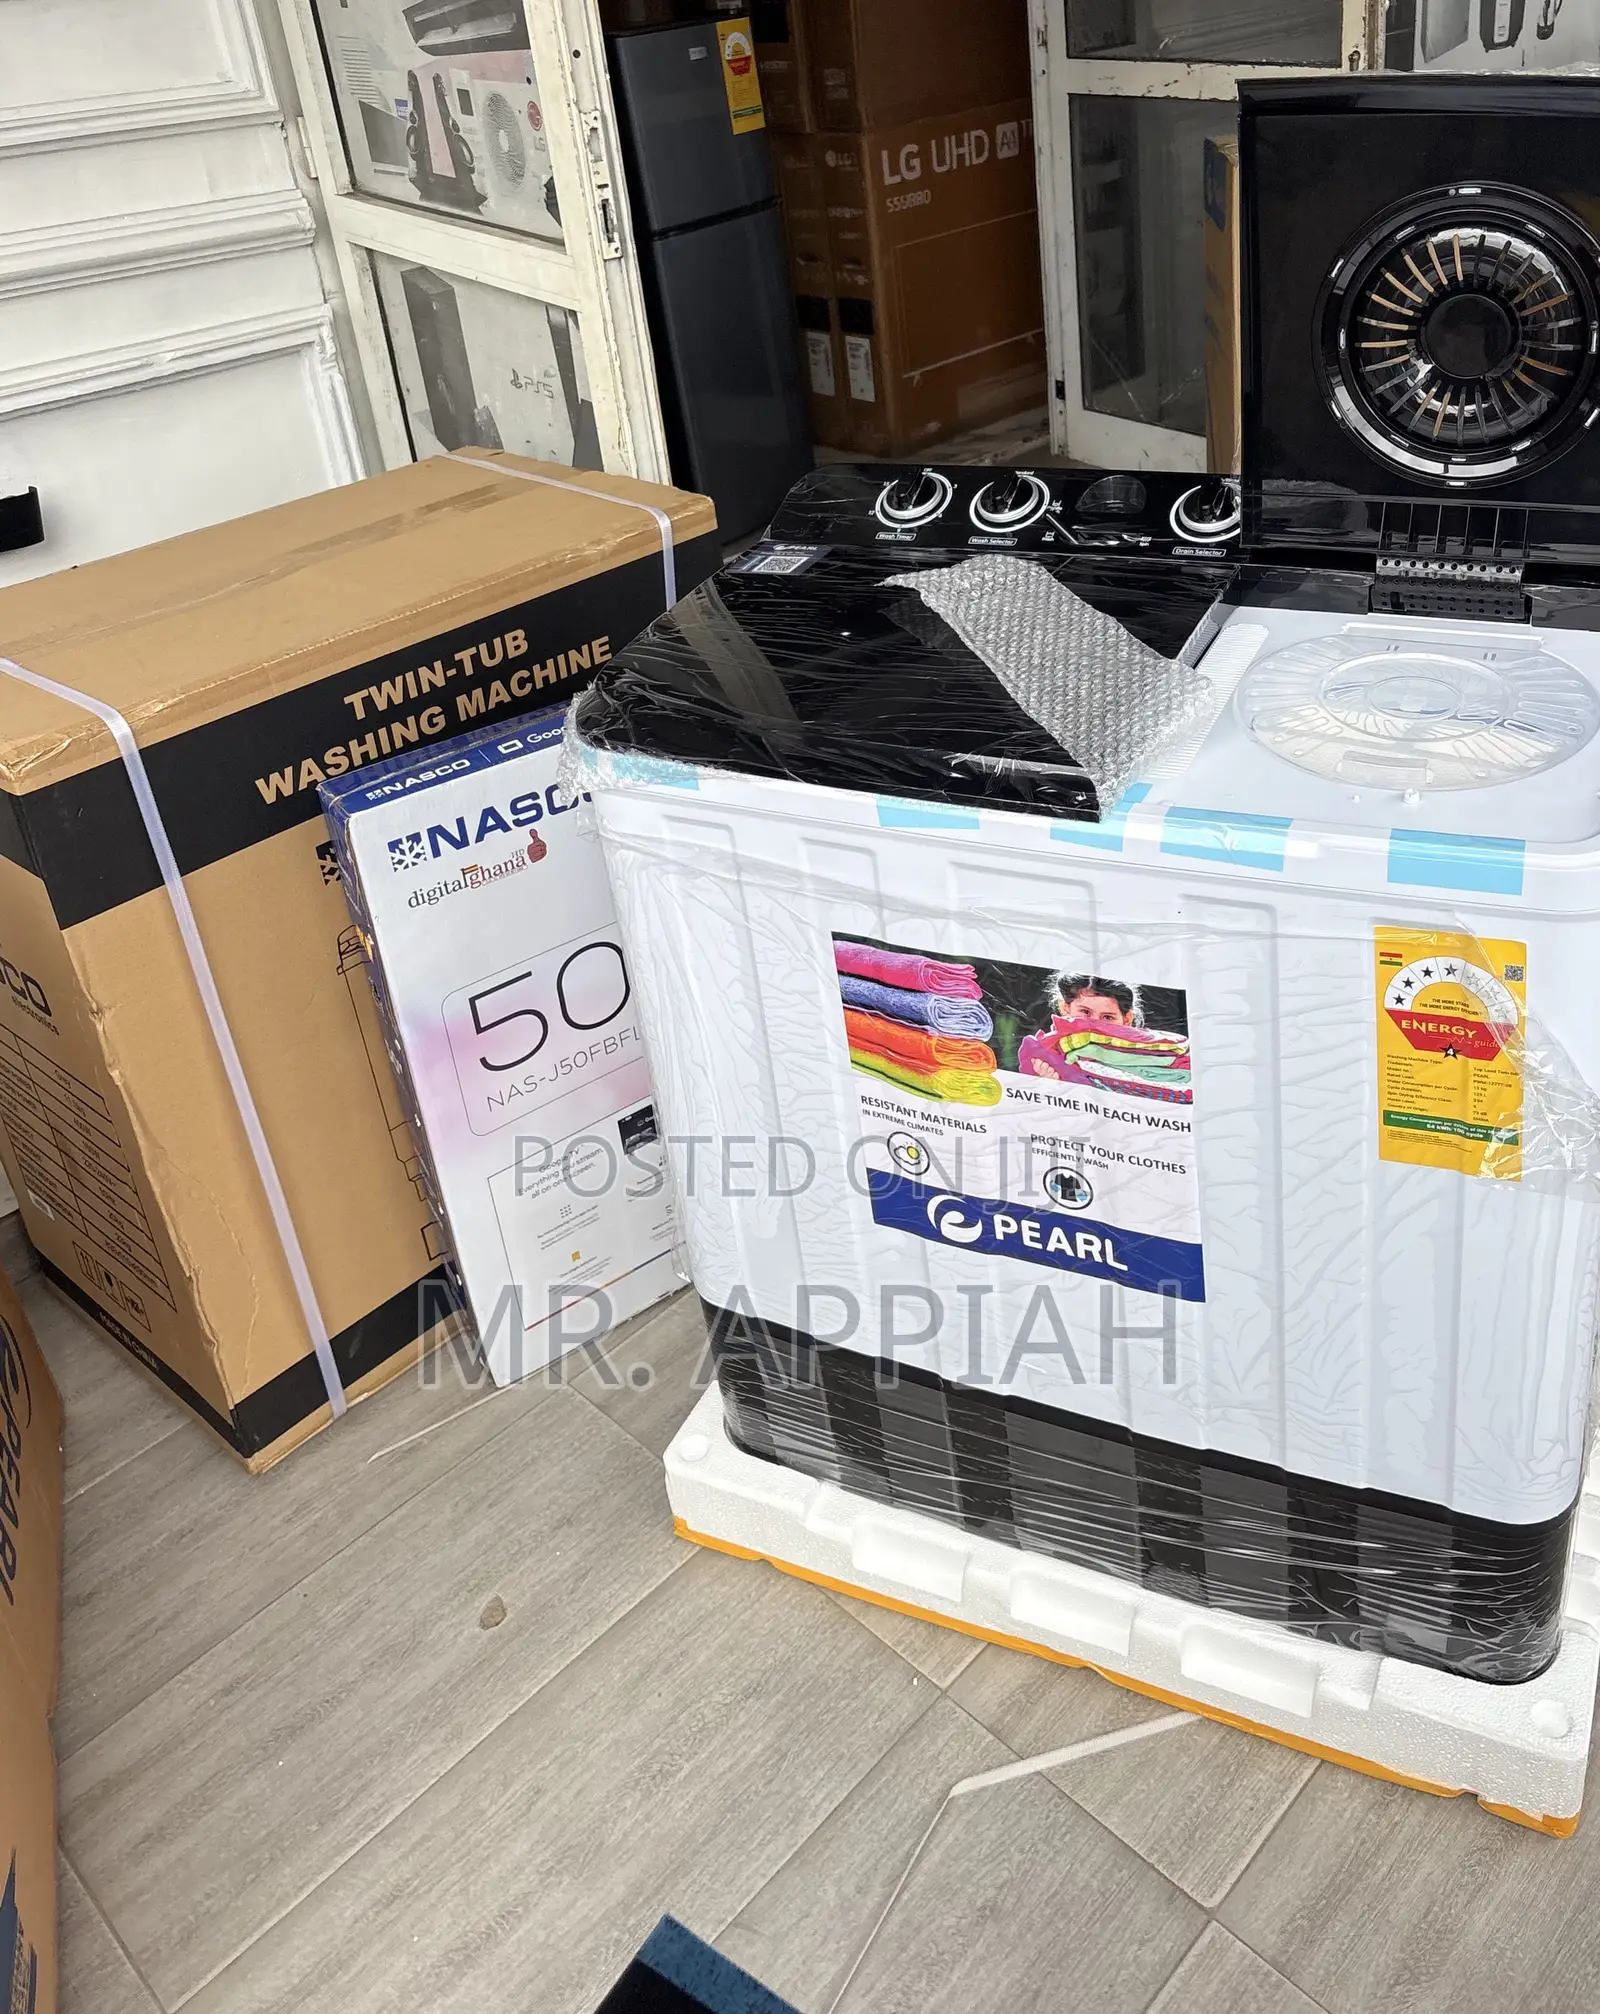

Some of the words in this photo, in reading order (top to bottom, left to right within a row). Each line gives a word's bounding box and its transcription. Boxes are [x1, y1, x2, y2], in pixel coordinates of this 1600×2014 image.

[882, 143, 922, 186] LG
[930, 129, 990, 173] UHD
[343, 628, 529, 721] TWIN-TUB
[254, 705, 447, 806] WASHING
[455, 636, 613, 722] MACHINE
[382, 758, 471, 796] NASCO
[426, 783, 592, 859] NASC
[469, 941, 631, 1072] 50
[1401, 1019, 1477, 1038] ENERGY
[861, 1095, 917, 1119] RESISTANT
[921, 1112, 987, 1134] MATERIALS
[872, 1110, 905, 1126] EXTREME
[907, 1121, 944, 1136] CLIMATES
[1006, 1087, 1042, 1104] SAVE
[1044, 1095, 1080, 1111] TIME
[1084, 1102, 1099, 1115] IN
[1103, 1107, 1141, 1125] EACH
[1145, 1115, 1191, 1133] WASH
[1409, 1117, 1443, 1125] Consumption
[518, 1170, 560, 1196] Everything
[561, 1163, 575, 1172] you
[576, 1148, 604, 1165] stream.
[538, 1155, 568, 1173] Google
[553, 1176, 568, 1187] one
[569, 1162, 596, 1179] screen.
[1030, 1133, 1086, 1152] PROTECT
[1089, 1145, 1125, 1163] YOUR
[1128, 1155, 1187, 1175] CLOTHES
[1031, 1147, 1082, 1163] EFFICIENTLY
[1083, 1158, 1109, 1170] WASH
[993, 1213, 1129, 1272] PEARL
